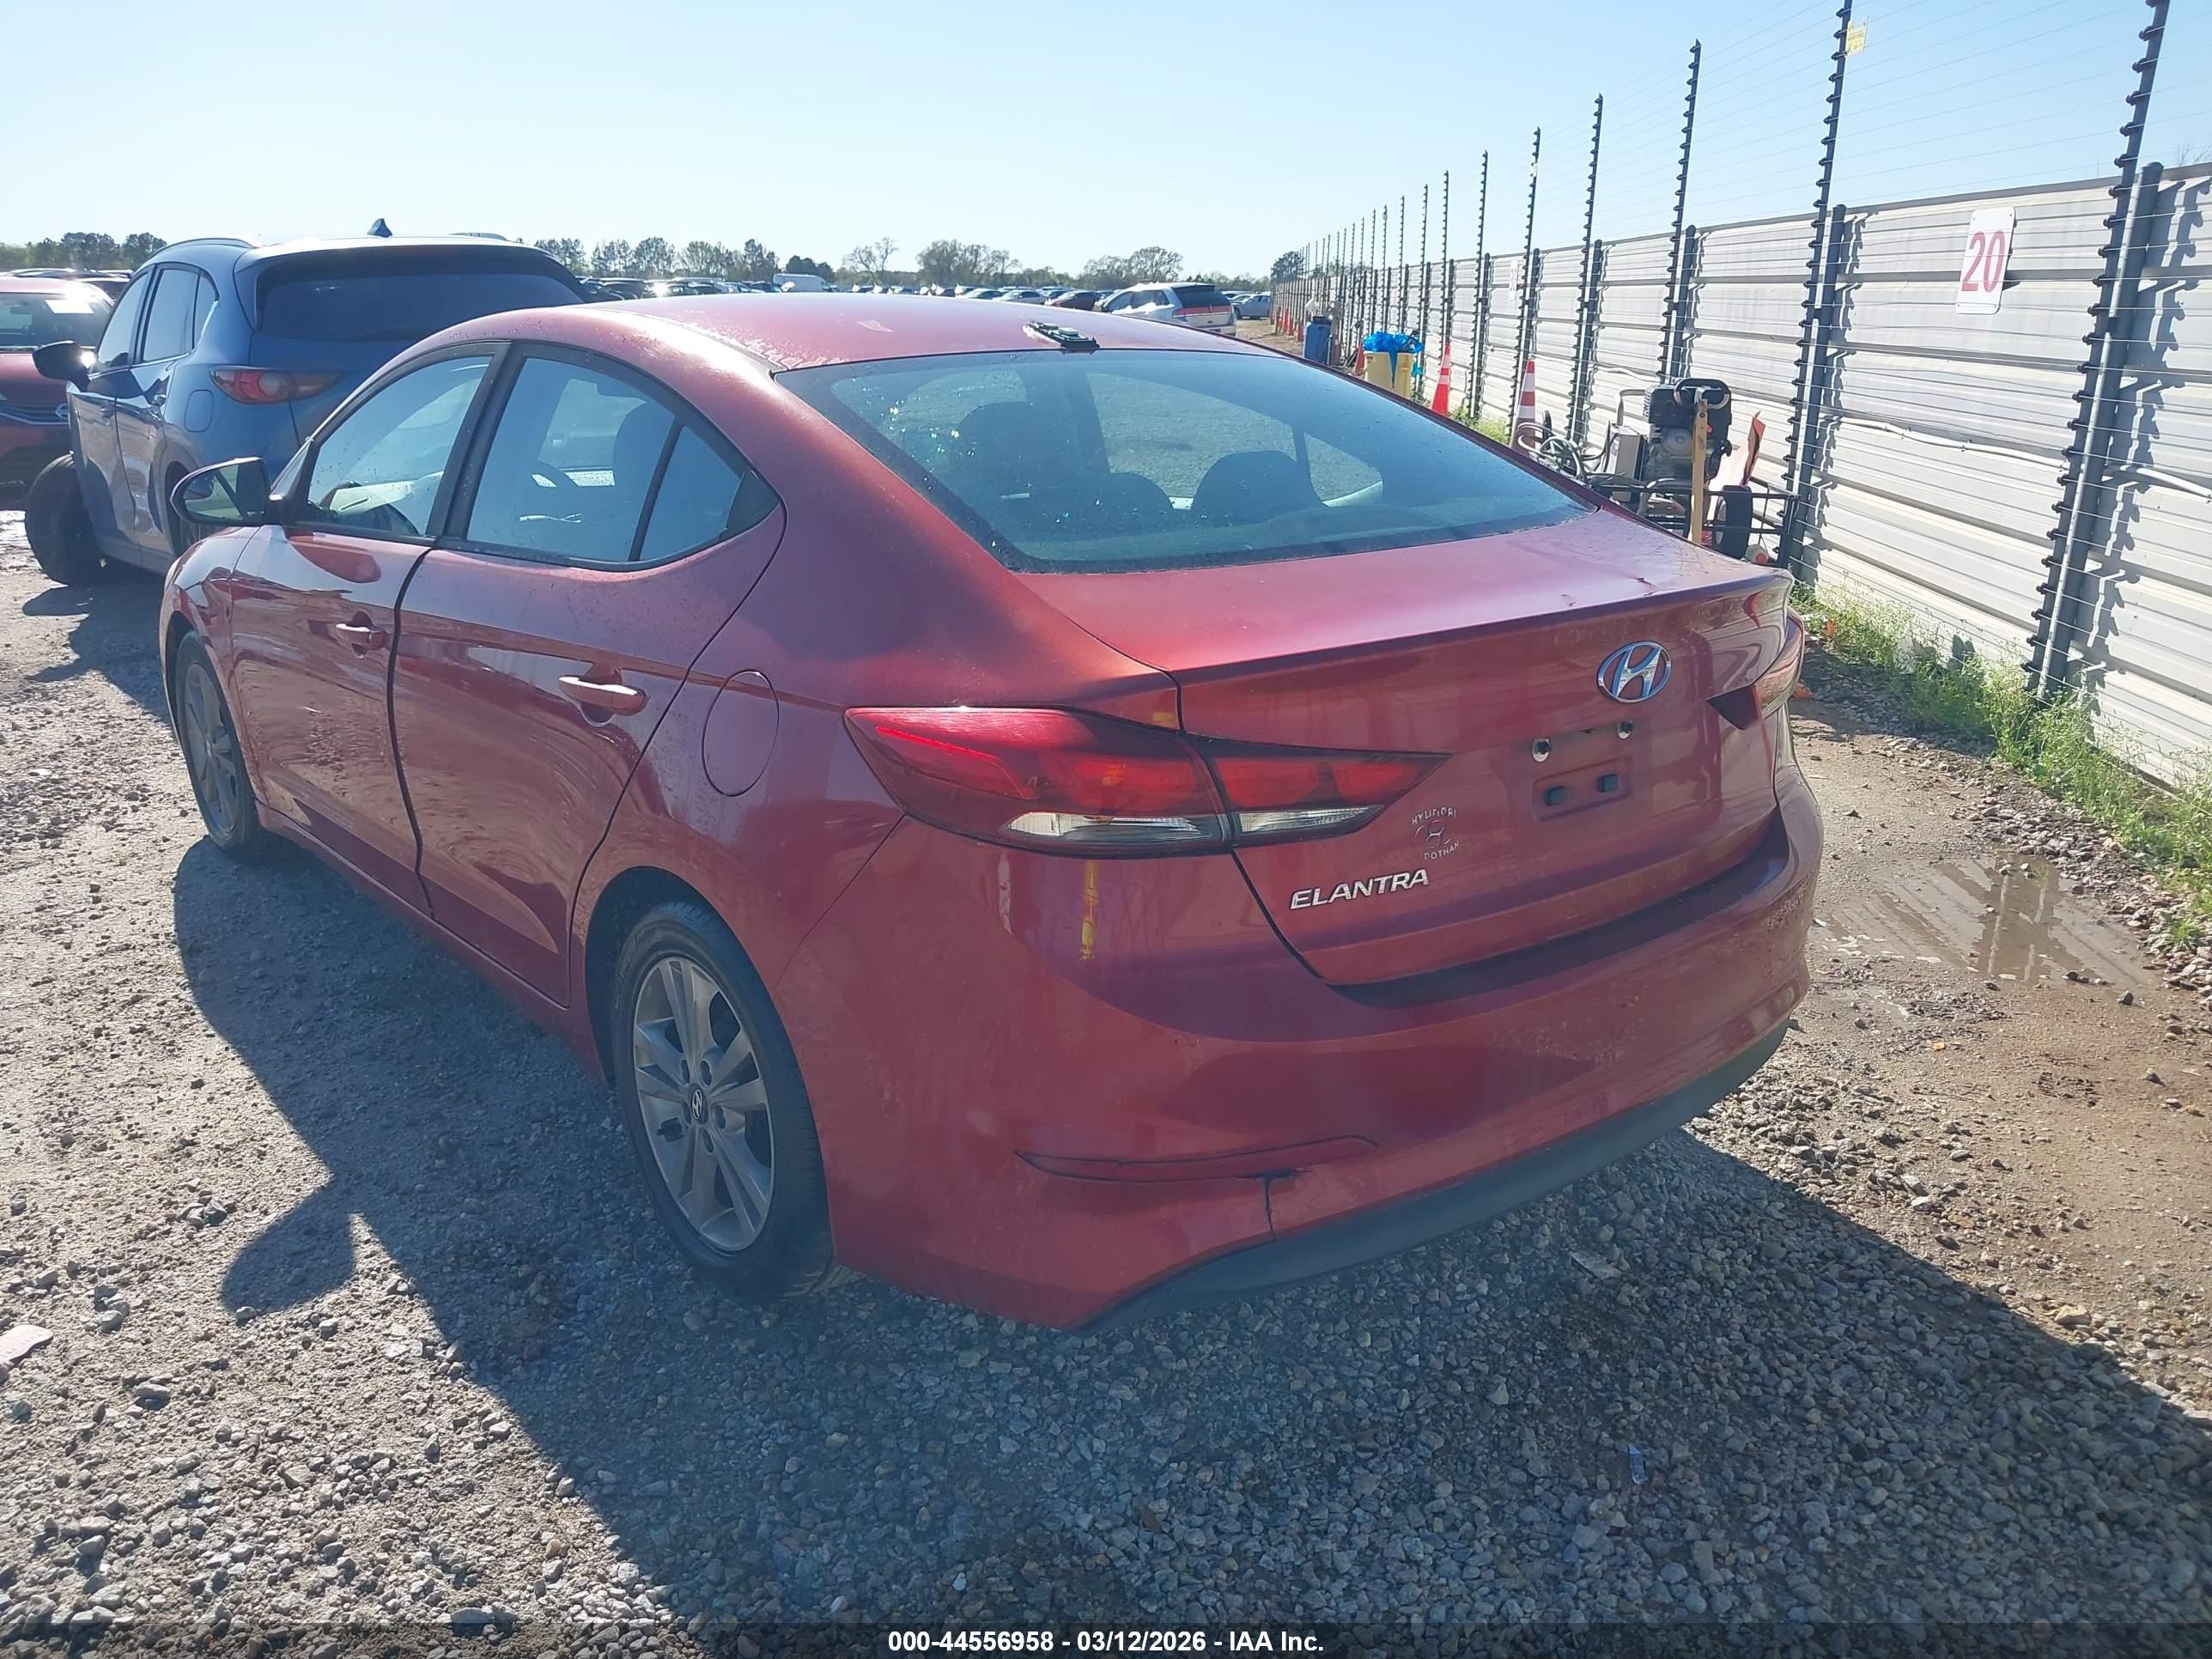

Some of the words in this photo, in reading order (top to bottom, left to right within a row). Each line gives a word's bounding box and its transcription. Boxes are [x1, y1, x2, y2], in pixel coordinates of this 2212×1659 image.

[1961, 230, 2005, 293] 20
[1424, 840, 1459, 860] DOTHAN
[1290, 869, 1429, 910] ELANTRA
